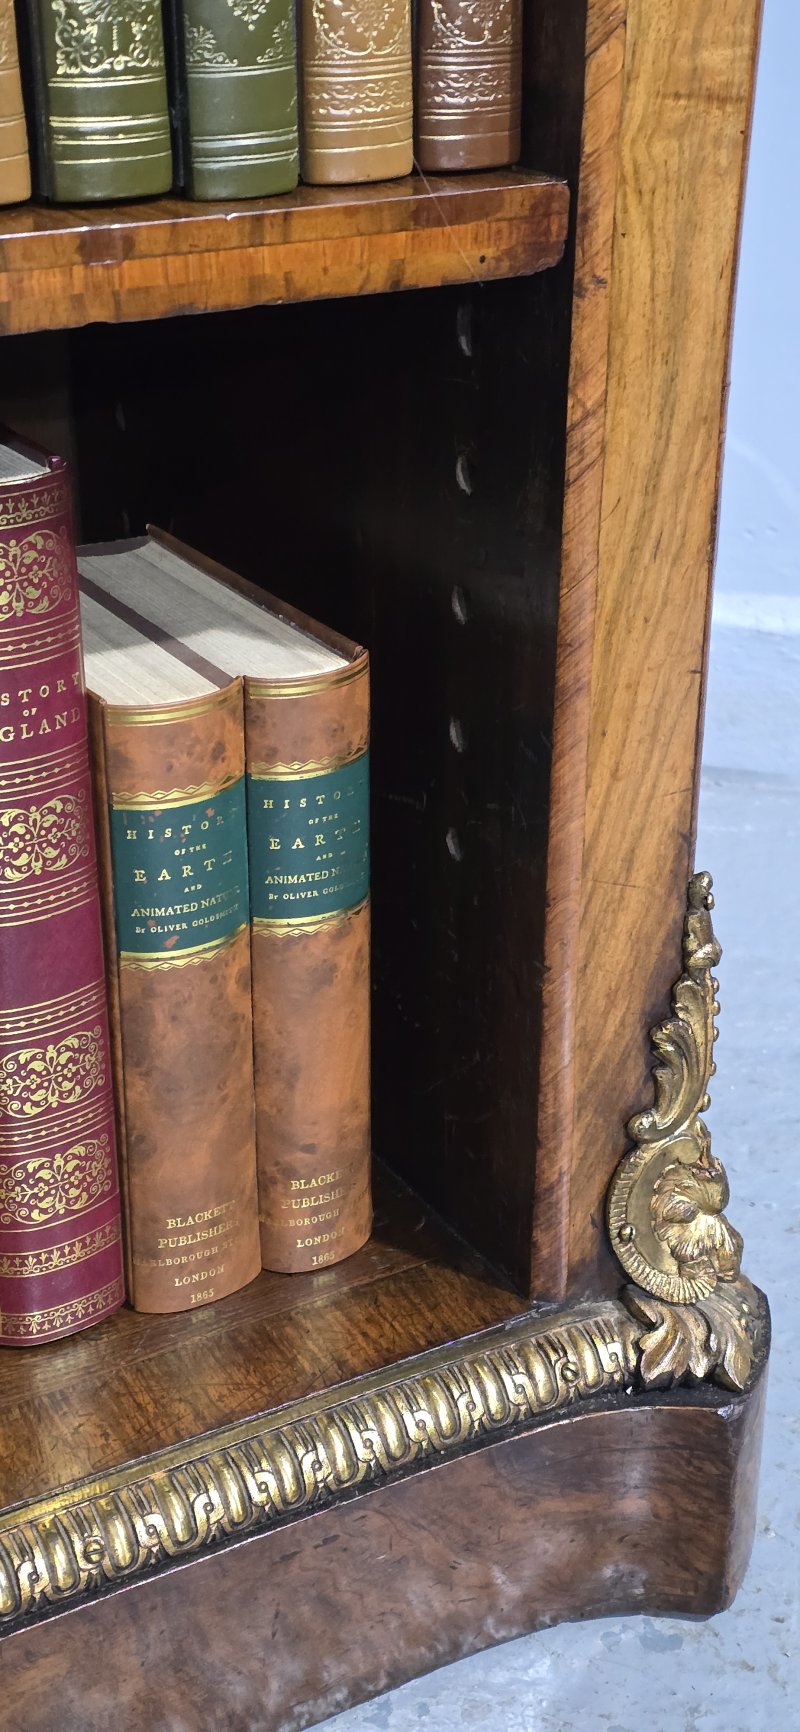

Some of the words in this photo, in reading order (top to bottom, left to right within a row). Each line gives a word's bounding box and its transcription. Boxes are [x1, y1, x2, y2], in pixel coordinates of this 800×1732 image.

[1, 671, 80, 706] STORY
[22, 707, 37, 717] OF
[0, 707, 80, 742] GLAND
[263, 790, 354, 809] HISTO
[126, 808, 237, 840] HISTOR
[174, 848, 186, 856] OF
[189, 843, 207, 853] THE
[315, 852, 333, 861] AND
[264, 870, 330, 885] ANIMATED
[183, 883, 203, 893] AND
[282, 890, 319, 901] OLIVER
[131, 902, 199, 917] ANIMATED
[150, 923, 189, 933] OLIVER
[311, 1250, 336, 1266] 1865
[174, 1263, 226, 1287] LONDON
[190, 1288, 214, 1304] 1865
